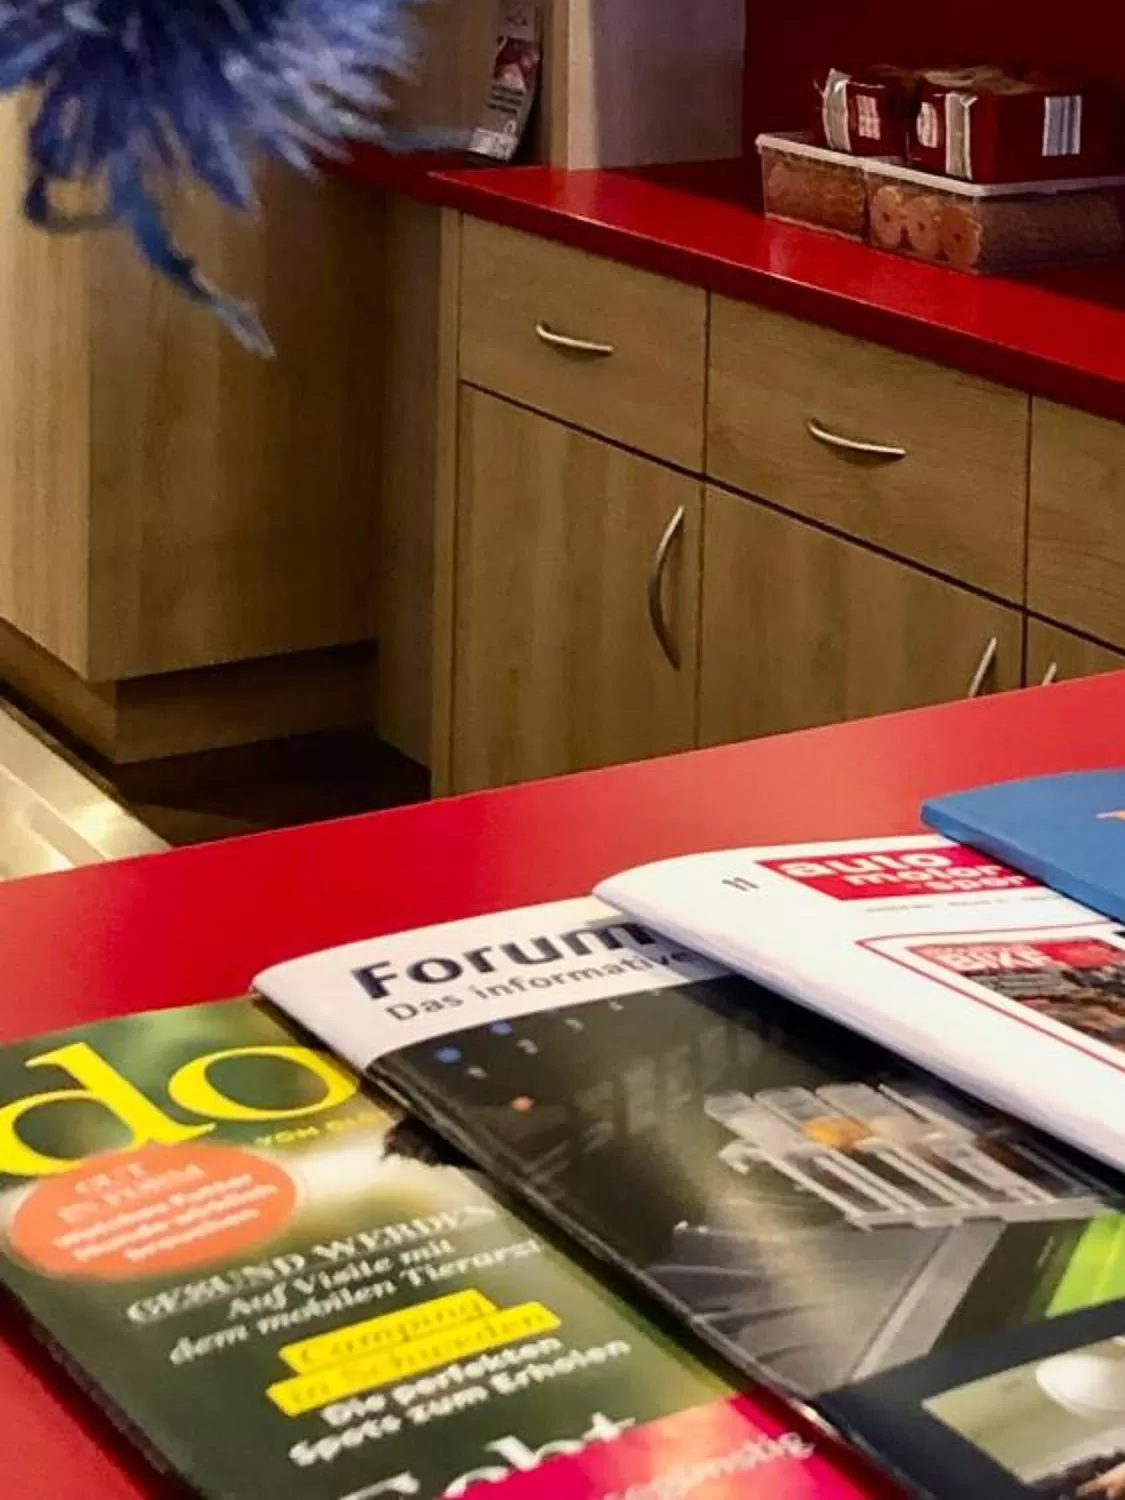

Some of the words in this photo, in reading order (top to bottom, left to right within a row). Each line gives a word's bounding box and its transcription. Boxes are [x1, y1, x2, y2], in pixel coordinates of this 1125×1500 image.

[350, 921, 658, 999] Forum
[385, 995, 465, 1021] Das
[227, 1283, 288, 1320] Auf
[293, 1255, 391, 1297] Visite
[402, 1238, 455, 1265] mit
[170, 1323, 250, 1367] dem
[256, 1278, 397, 1335] mobilen
[391, 1337, 564, 1406] perfekten
[406, 1384, 489, 1424] zum
[490, 1339, 632, 1395] Erholen
